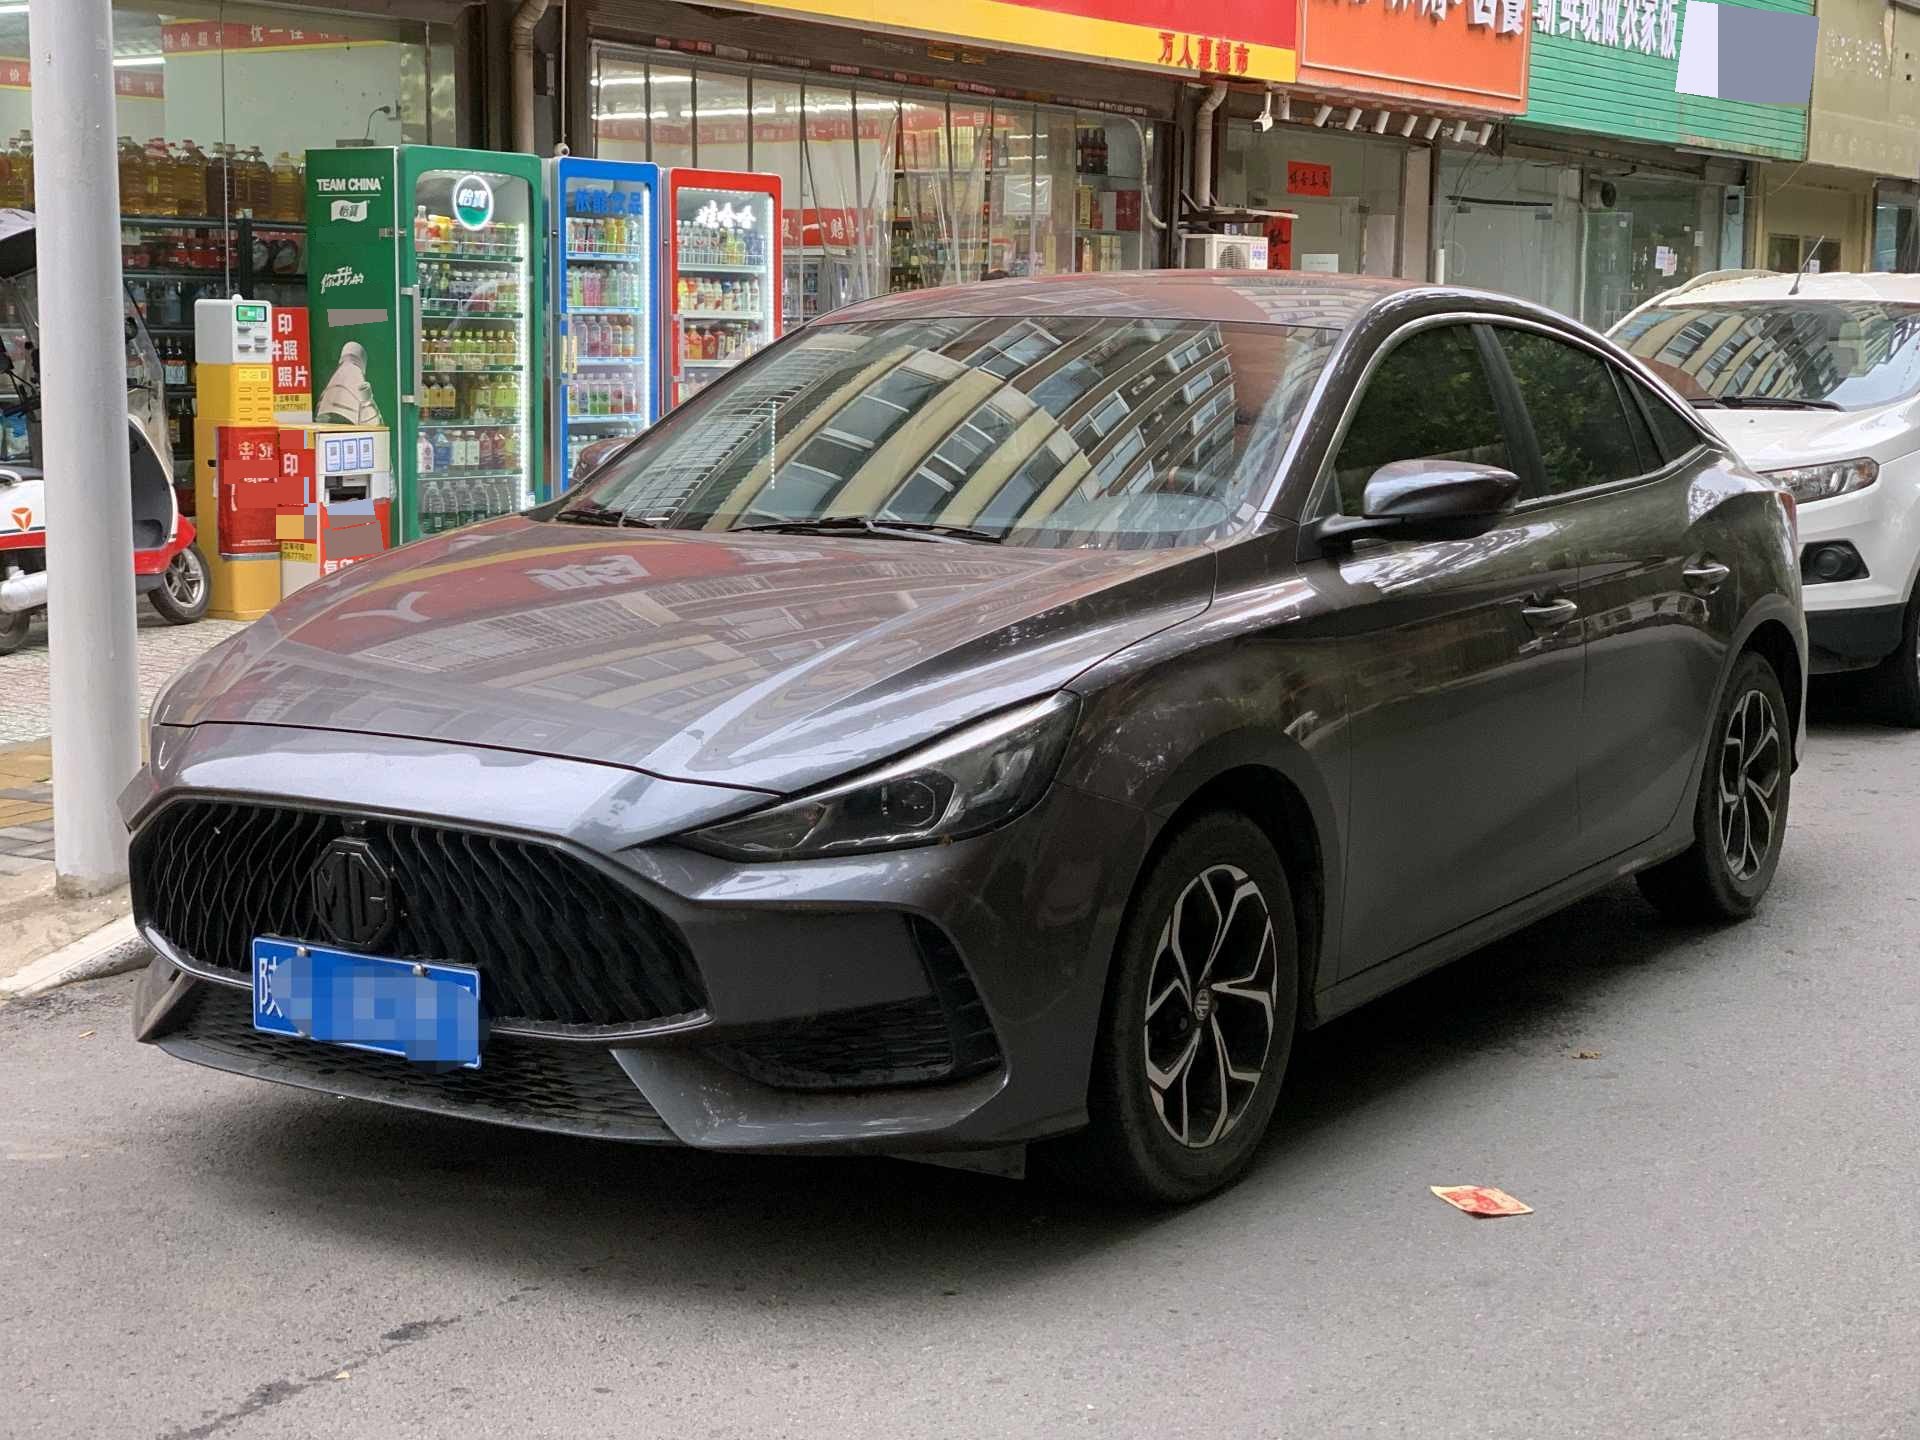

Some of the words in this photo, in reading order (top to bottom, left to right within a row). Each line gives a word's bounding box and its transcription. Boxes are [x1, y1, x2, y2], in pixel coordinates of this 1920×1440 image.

[316, 178, 346, 191] TEAM
[348, 177, 381, 191] CHINA
[277, 313, 293, 335] 印
[278, 365, 309, 388] 照片
[283, 452, 299, 477] 印
